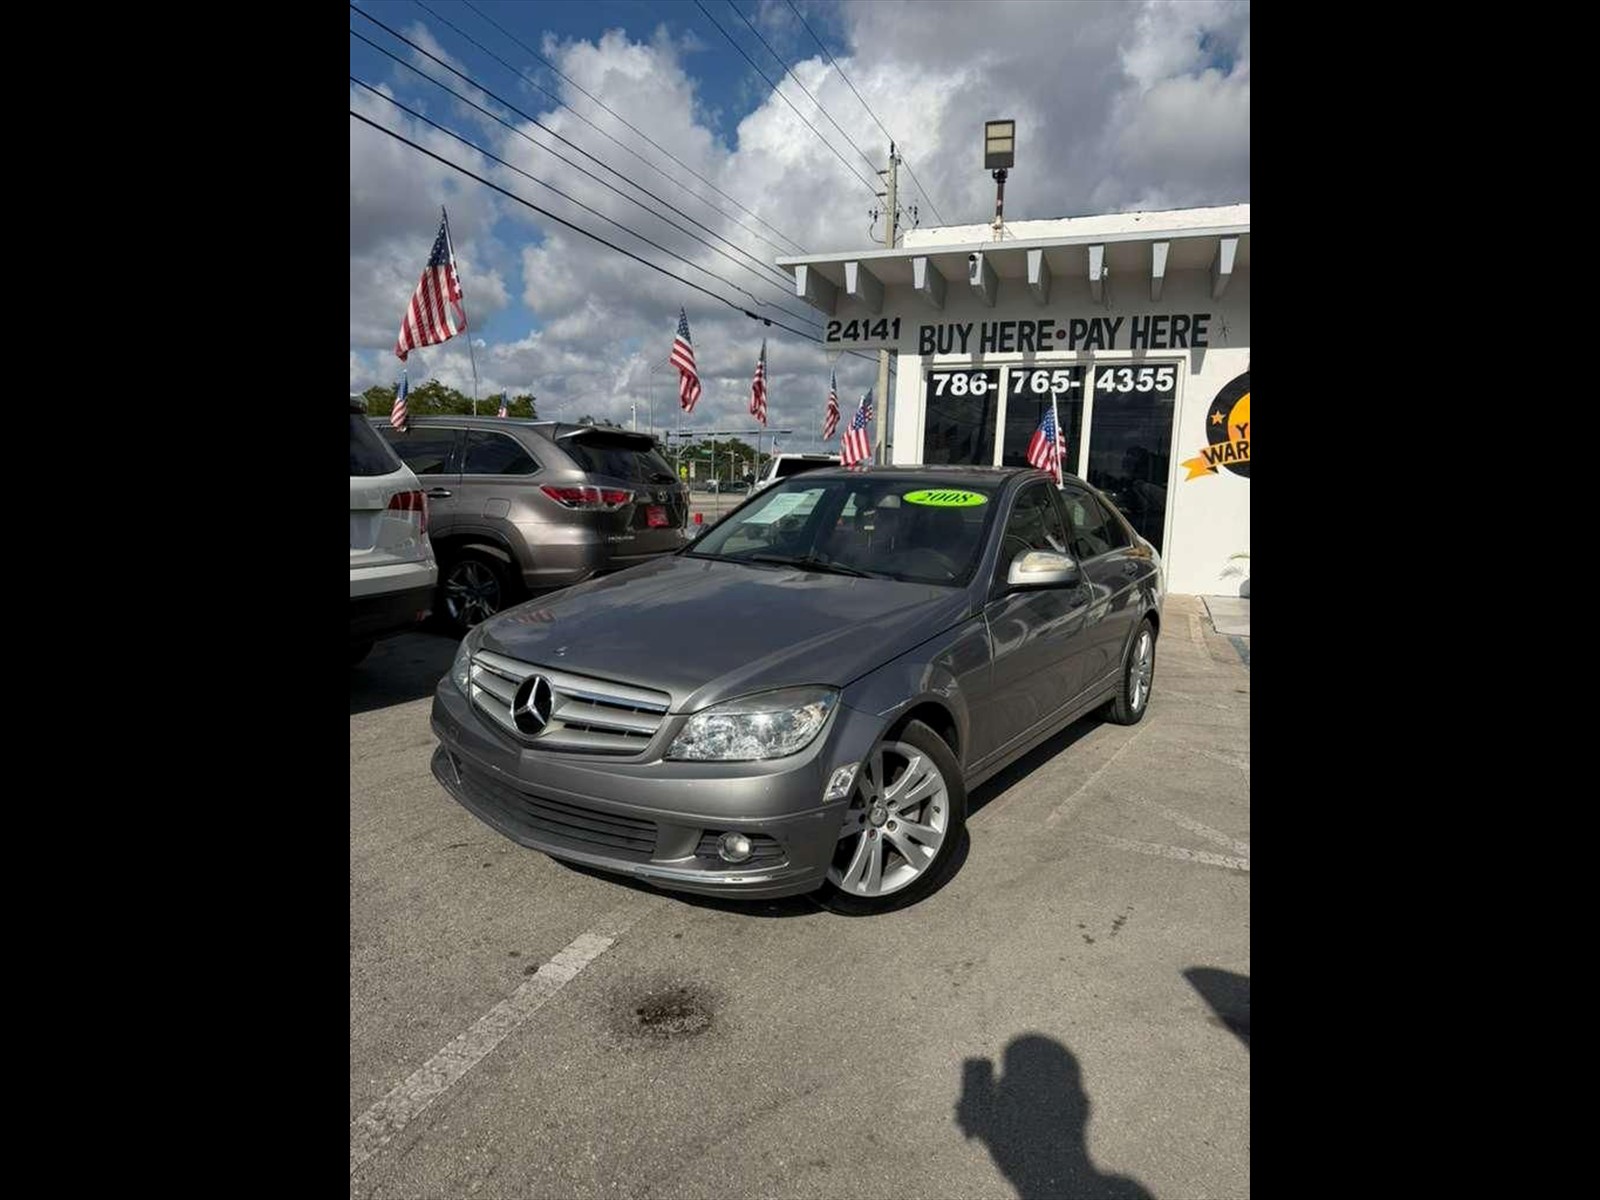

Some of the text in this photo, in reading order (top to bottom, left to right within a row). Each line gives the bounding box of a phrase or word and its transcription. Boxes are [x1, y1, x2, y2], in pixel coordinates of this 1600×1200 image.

[826, 317, 901, 342] 24141
[919, 313, 1211, 355] BUY HERE PAY HERE
[932, 367, 1174, 396] 786- 765- 4355
[916, 491, 975, 504] 2008
